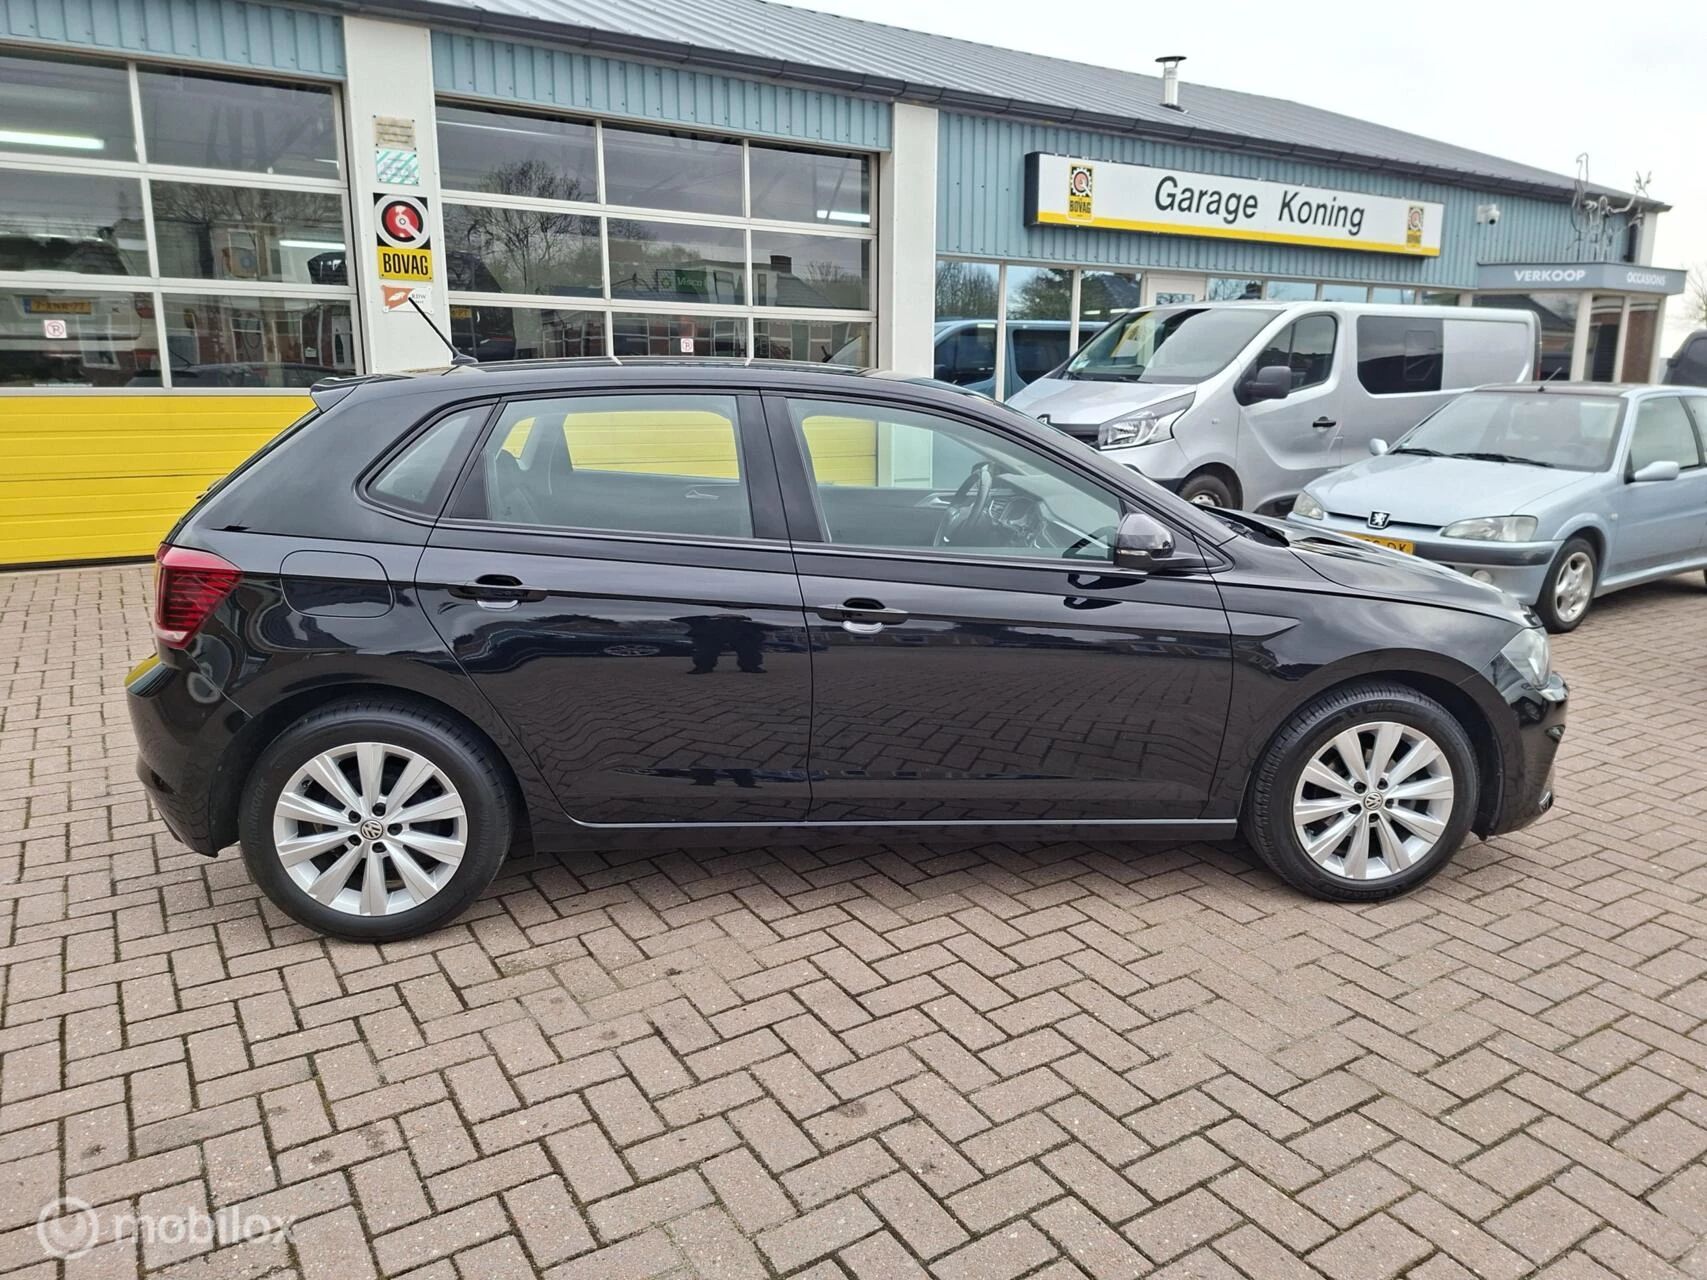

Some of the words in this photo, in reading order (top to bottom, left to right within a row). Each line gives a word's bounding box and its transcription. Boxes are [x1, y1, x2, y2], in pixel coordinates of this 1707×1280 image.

[1155, 175, 1258, 224] Garage
[1278, 189, 1365, 236] Koning
[383, 252, 428, 276] BOVAG
[1514, 270, 1586, 282] VERKOOP
[1626, 271, 1666, 286] OCCASIONS
